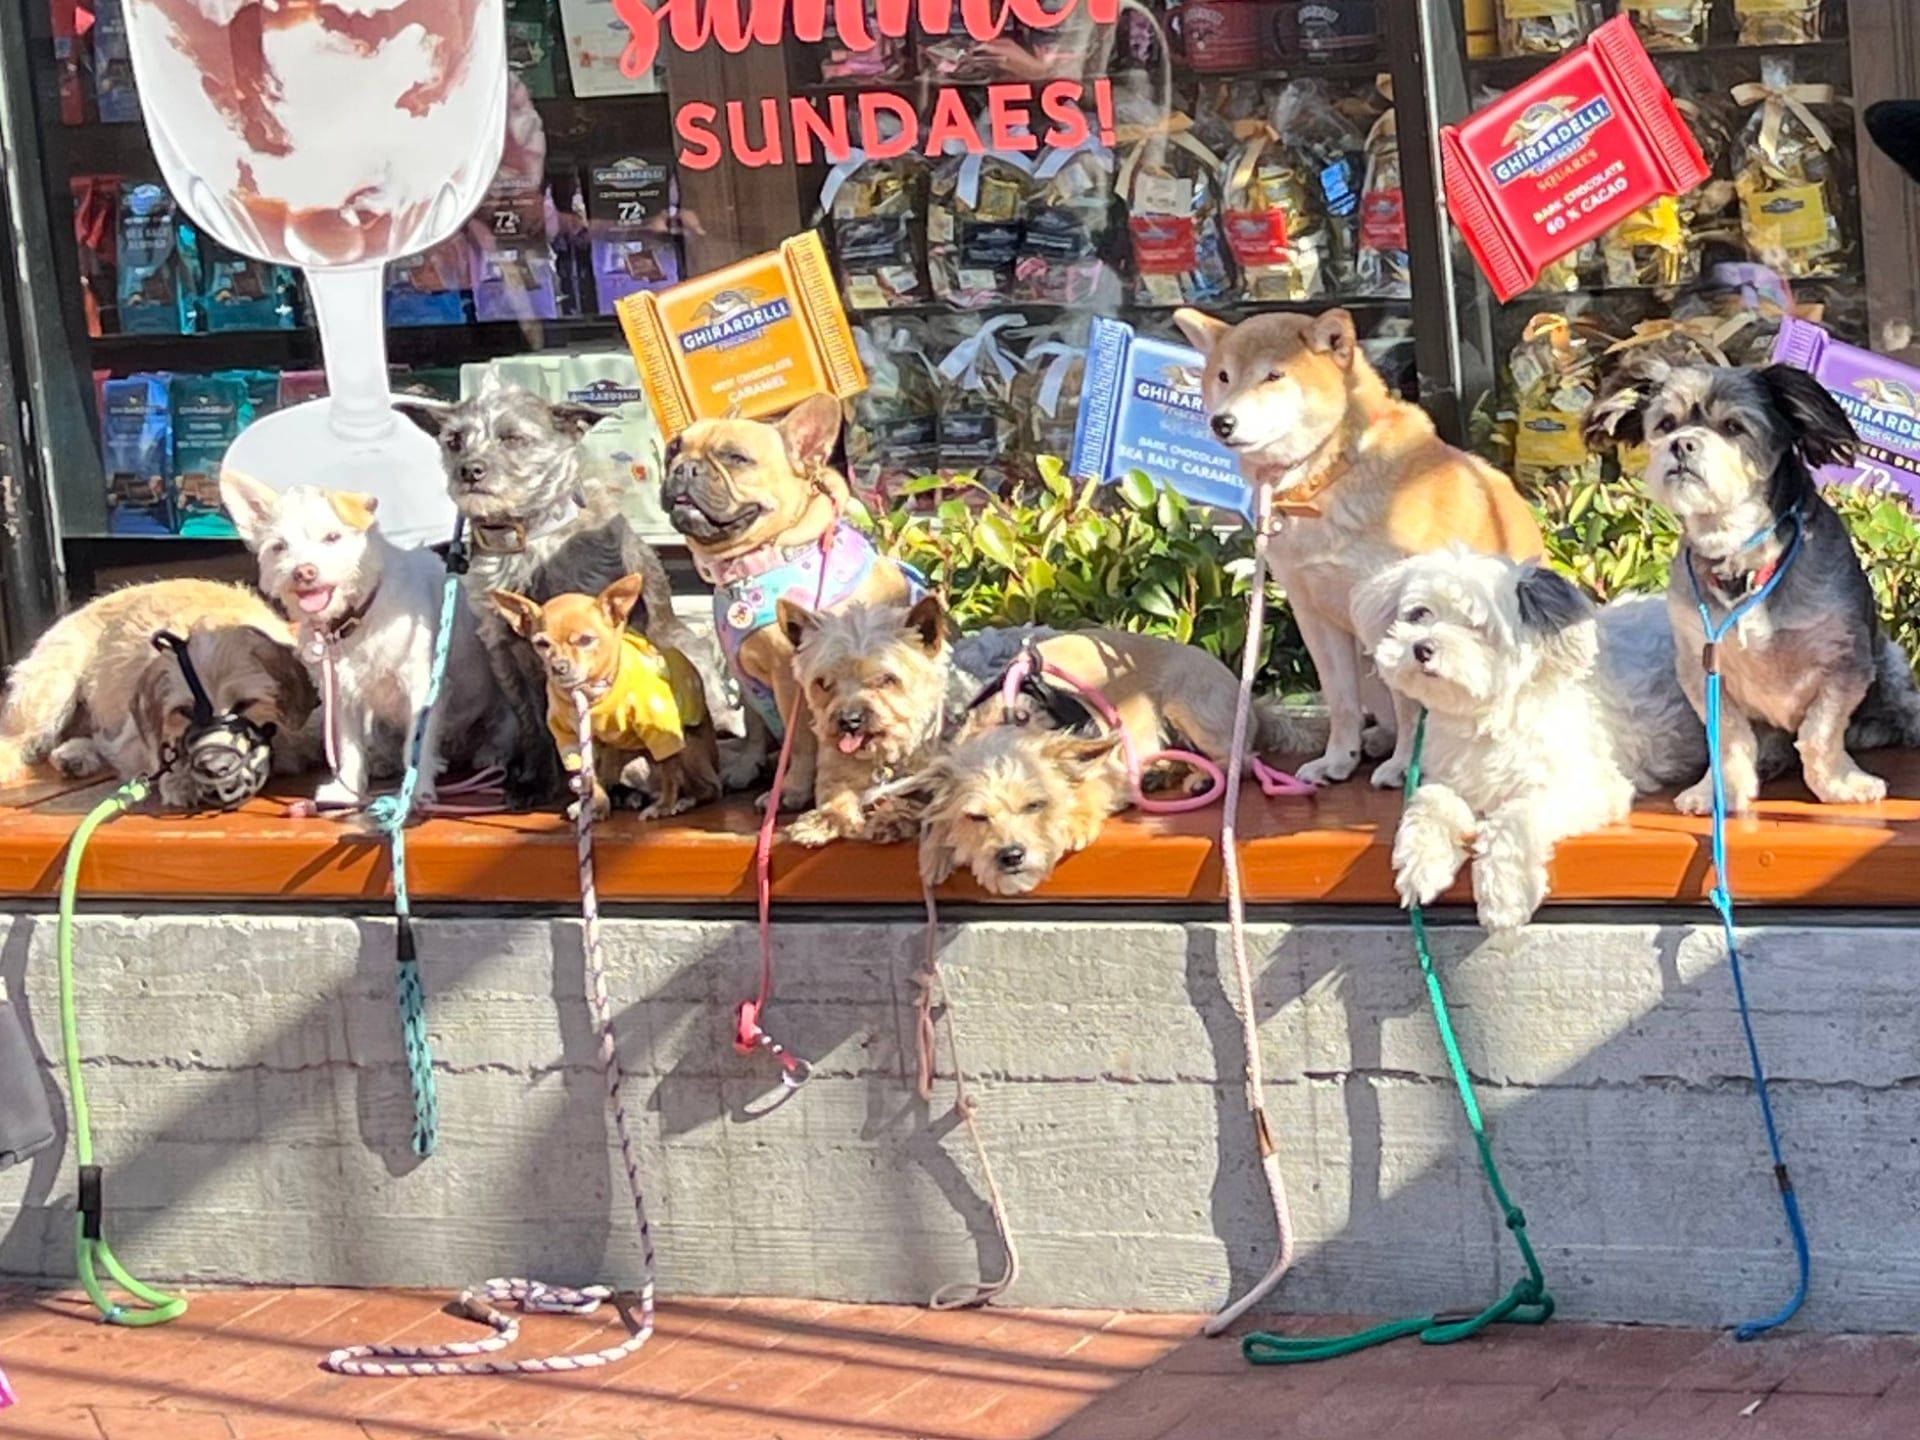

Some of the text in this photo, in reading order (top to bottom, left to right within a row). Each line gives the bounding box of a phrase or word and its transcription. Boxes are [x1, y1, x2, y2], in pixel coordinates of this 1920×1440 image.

[675, 79, 1117, 170] SUNDAES!
[1496, 103, 1609, 180] GHIRARDELLI
[1533, 160, 1626, 224] DARK CHOCOLATE
[1536, 148, 1599, 192] SQUARES
[1546, 177, 1628, 235] 60 % CACAO
[683, 302, 789, 349] GHIRARDELLI
[728, 375, 788, 404] CARAMEL
[1137, 382, 1203, 410] GHIRAR
[1832, 394, 1920, 440] HIRARDE
[1118, 444, 1245, 489] SEA SALT CARAMEL
[1138, 436, 1232, 469] DARK CHOCOLATE
